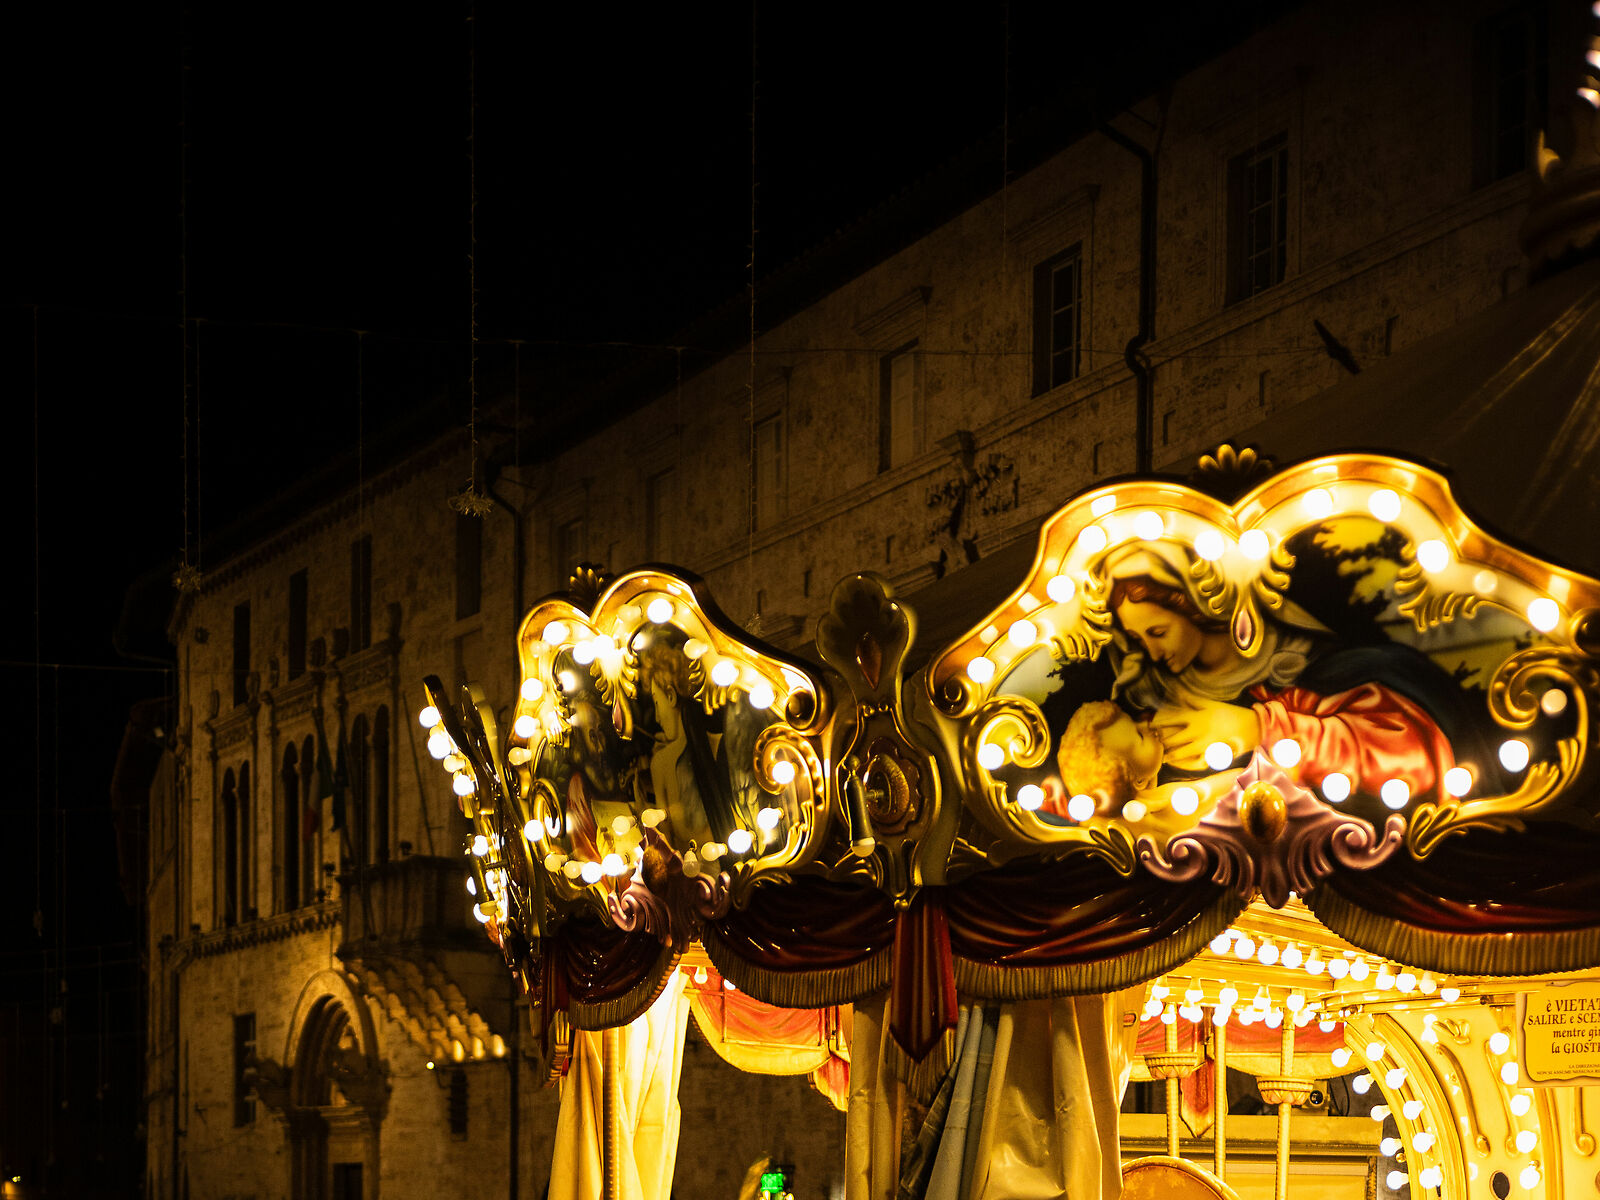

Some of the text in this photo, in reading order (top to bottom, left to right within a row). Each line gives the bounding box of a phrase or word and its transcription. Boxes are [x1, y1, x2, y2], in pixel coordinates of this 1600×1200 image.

[1546, 1000, 1552, 1013] è
[1528, 1014, 1566, 1025] SALIRE
[1570, 1016, 1575, 1024] e
[1553, 1028, 1586, 1038] mentre
[1551, 1042, 1560, 1054] la
